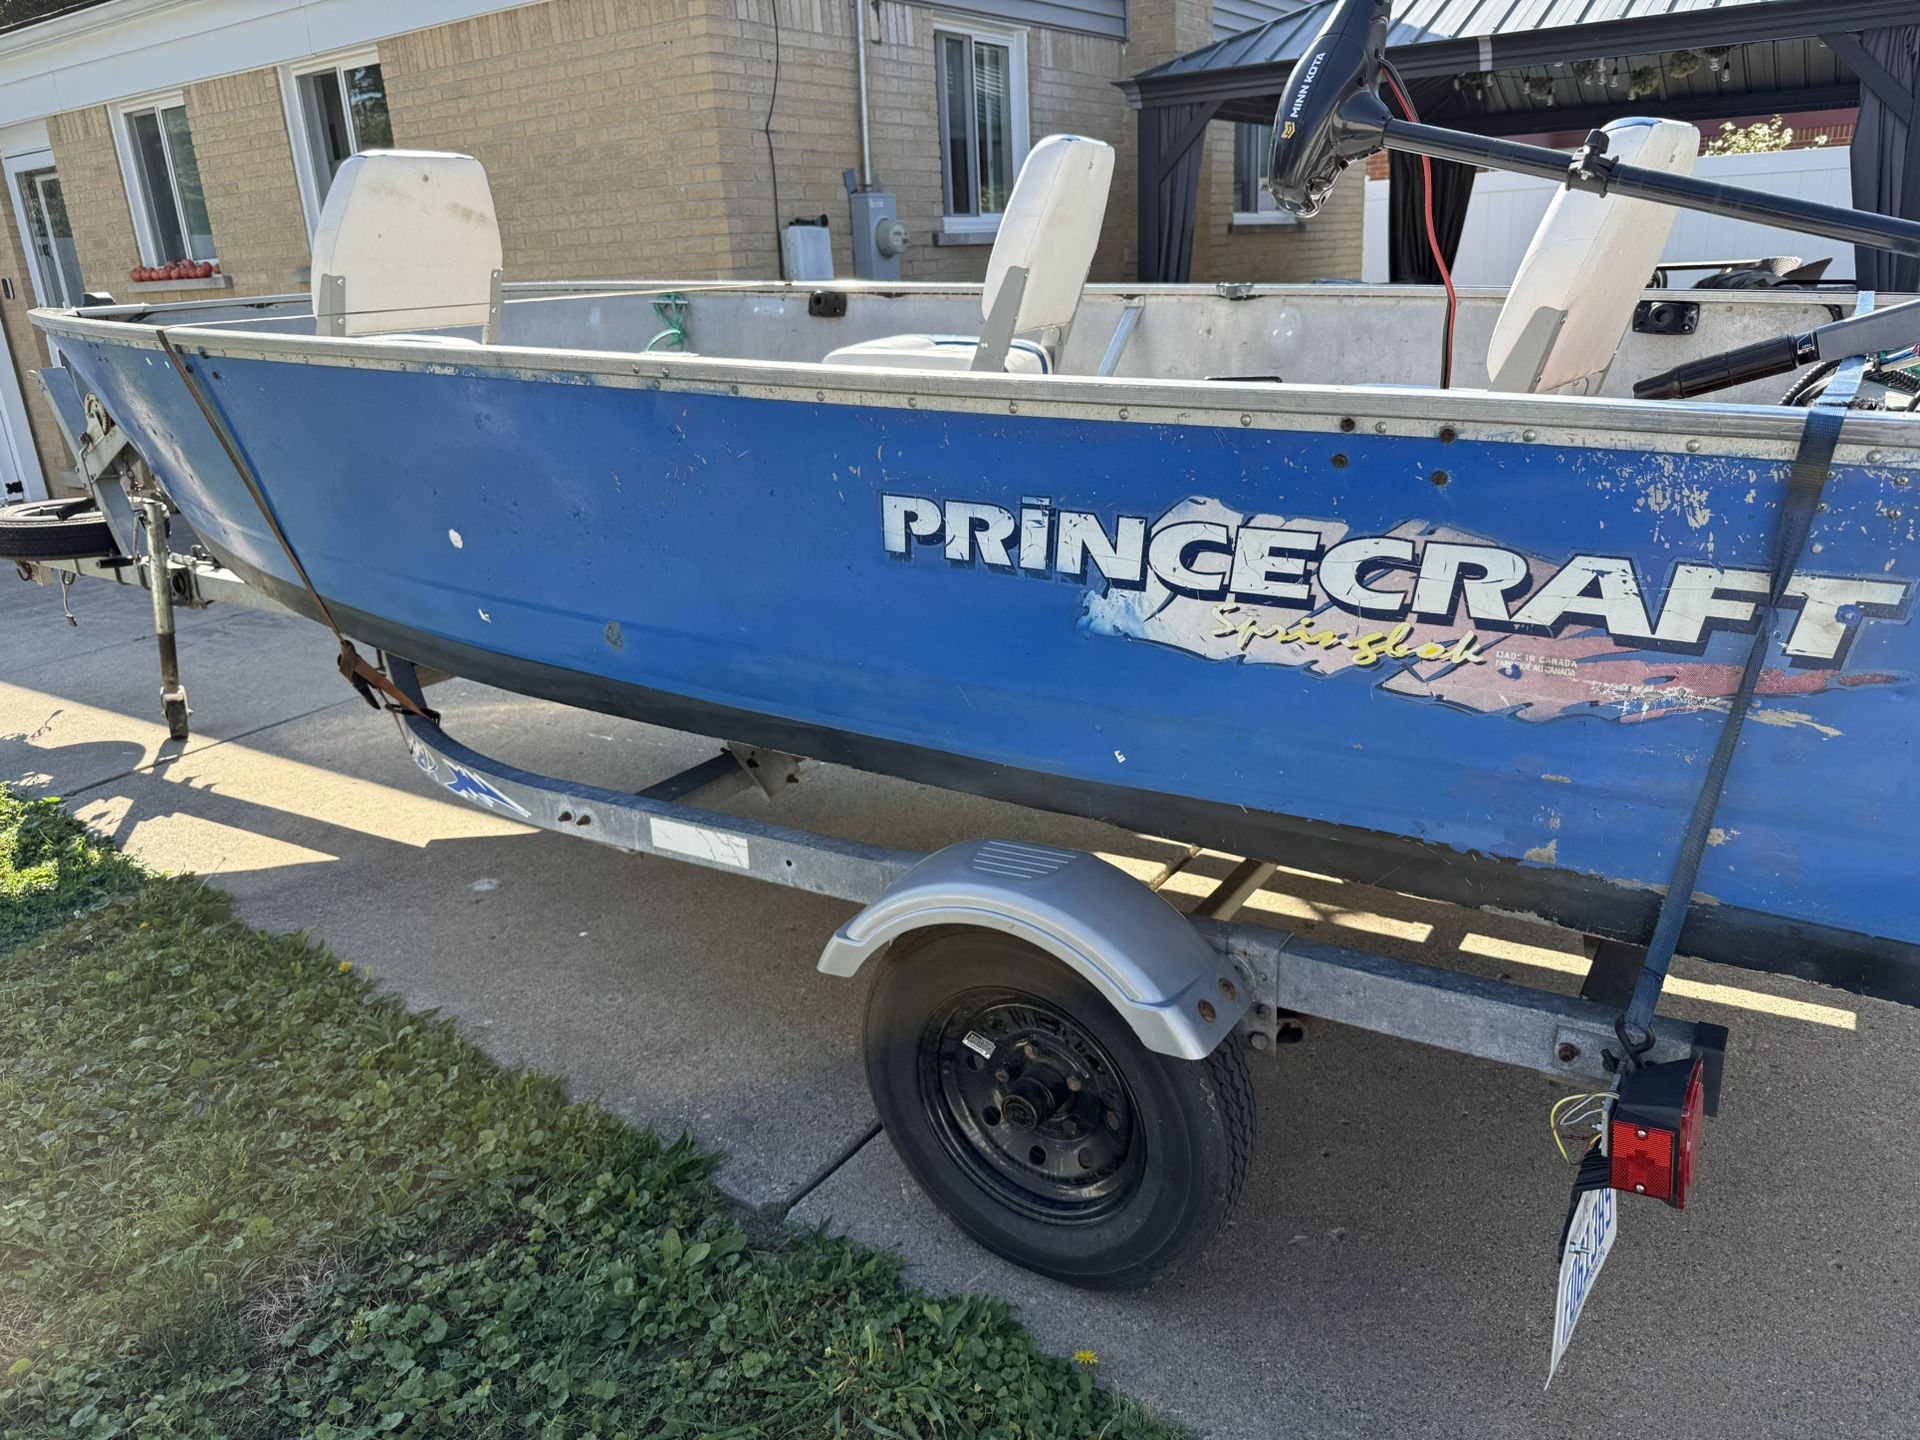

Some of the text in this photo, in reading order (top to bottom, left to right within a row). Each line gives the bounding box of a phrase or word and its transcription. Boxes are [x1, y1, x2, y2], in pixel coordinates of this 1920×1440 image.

[1290, 52, 1326, 118] MINN KOTA
[1525, 654, 1536, 663] IN
[1538, 655, 1577, 669] CANADA
[1532, 663, 1544, 673] AU
[1545, 665, 1576, 677] CANADA
